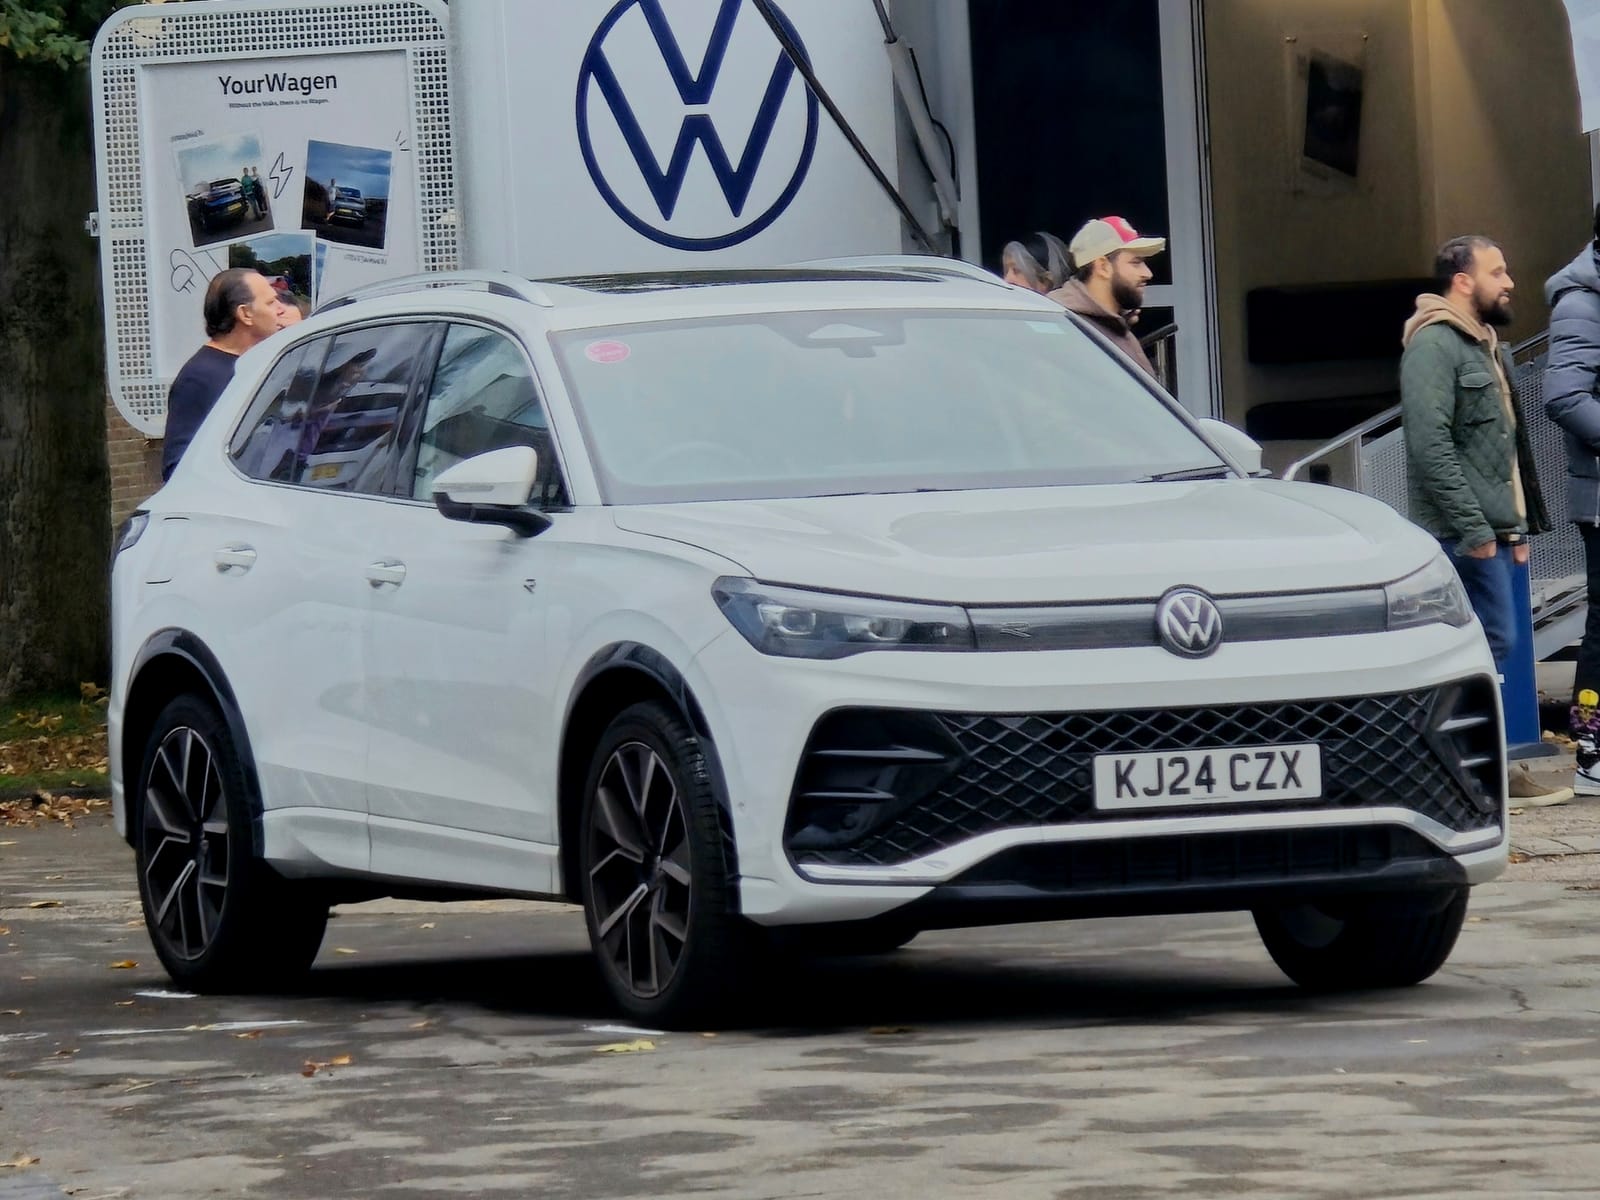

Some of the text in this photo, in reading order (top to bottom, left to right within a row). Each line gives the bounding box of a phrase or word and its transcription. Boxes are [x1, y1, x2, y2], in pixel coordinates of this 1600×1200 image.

[218, 73, 337, 96] YourWagen
[1114, 750, 1303, 799] KJ24 CZX
